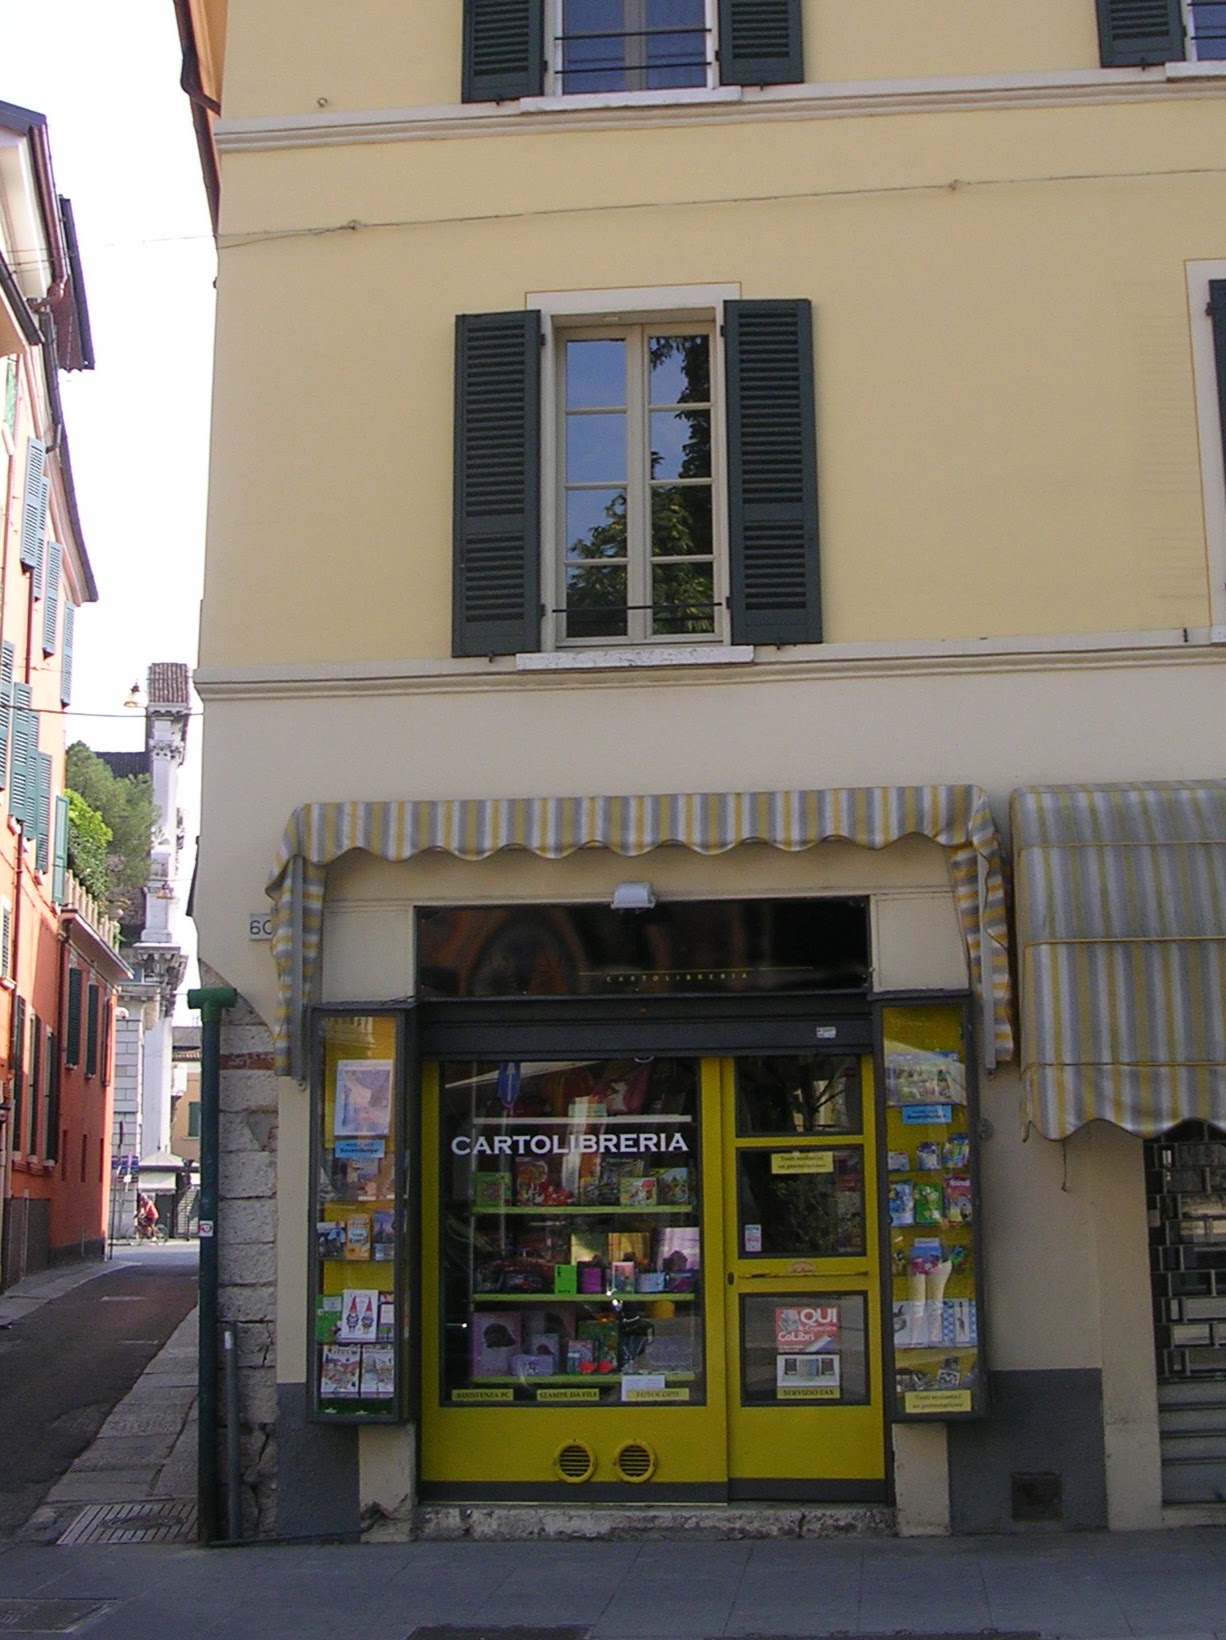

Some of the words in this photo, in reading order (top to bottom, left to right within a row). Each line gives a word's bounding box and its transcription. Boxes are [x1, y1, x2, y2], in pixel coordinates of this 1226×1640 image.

[605, 973, 748, 983] CARTOLIBRERIA
[450, 1132, 690, 1156] CARTOLIBRERIA
[800, 1307, 838, 1326] QUI
[777, 1331, 815, 1342] CoLibri
[456, 1391, 499, 1399] ASSISTENZA
[539, 1391, 568, 1399] STAMPE
[635, 1390, 680, 1398] FOTOCOPIE
[783, 1389, 818, 1397] SERVIZIO
[819, 1388, 835, 1396] FAX
